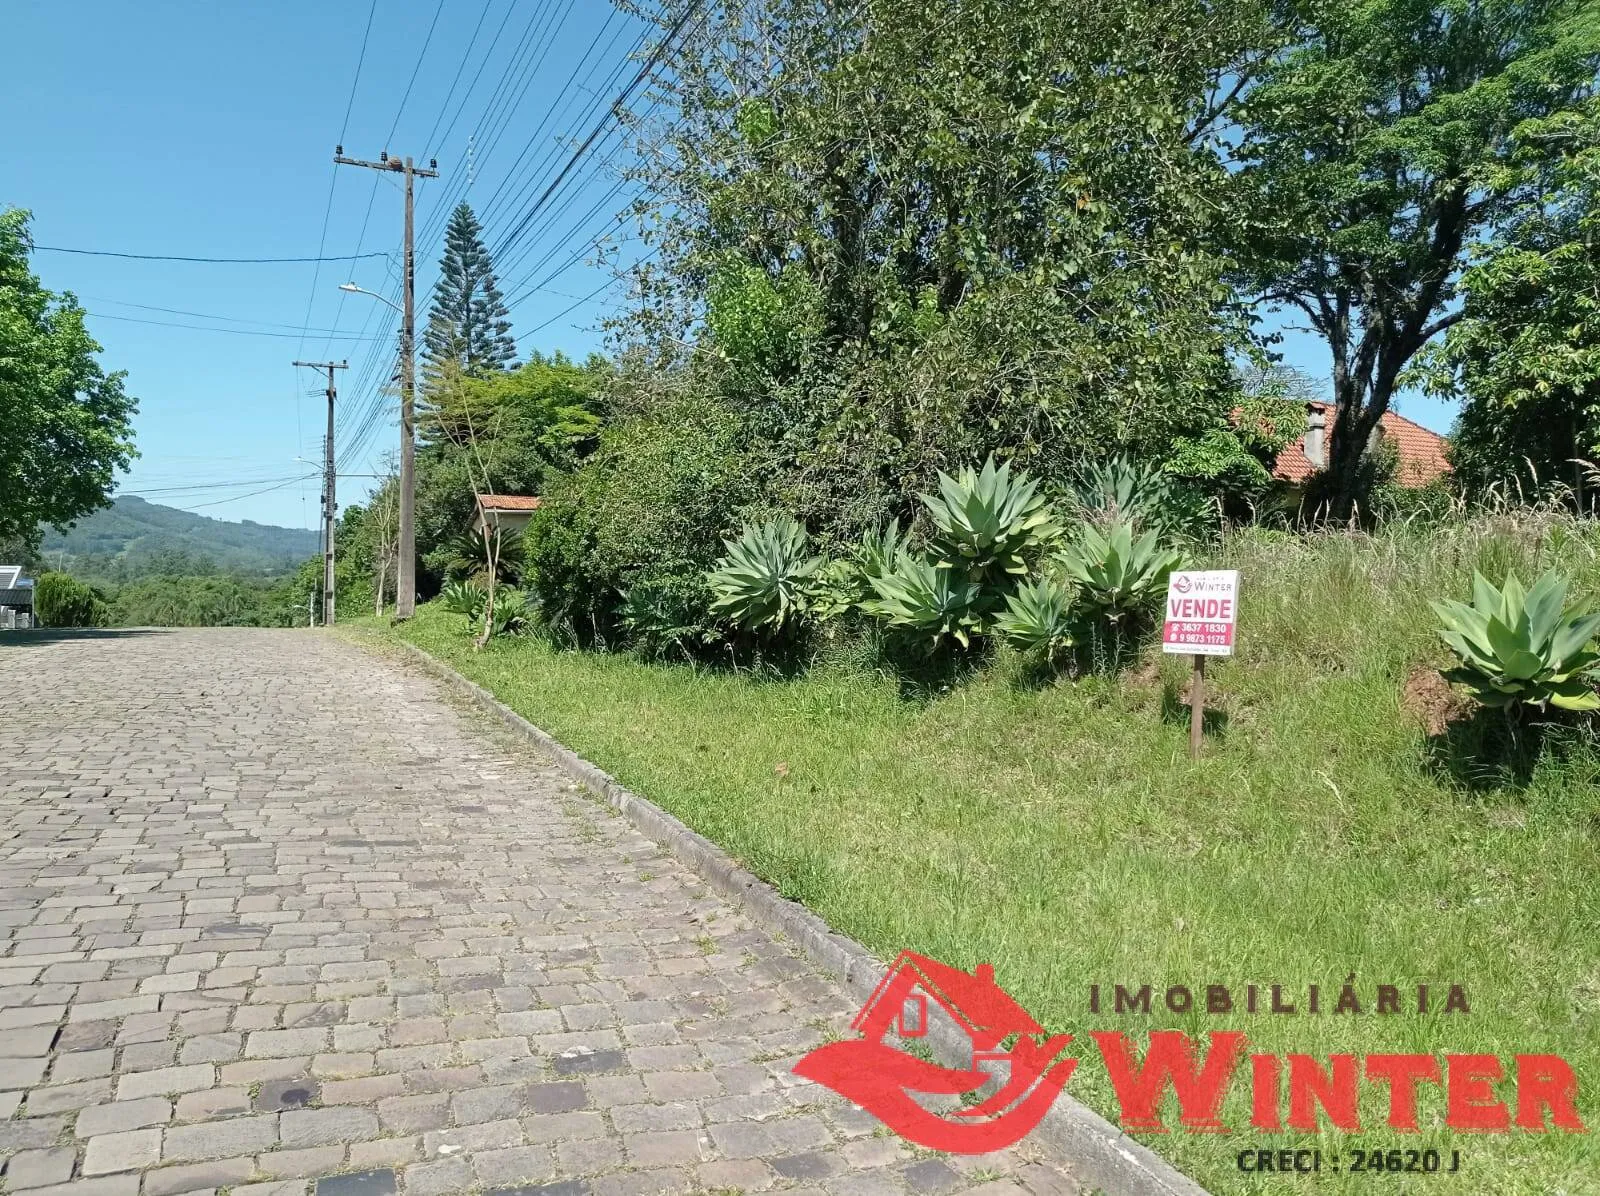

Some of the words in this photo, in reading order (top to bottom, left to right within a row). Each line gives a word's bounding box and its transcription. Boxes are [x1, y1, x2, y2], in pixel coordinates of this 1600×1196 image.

[1171, 599, 1232, 618] VENDE
[1205, 624, 1226, 633] 1830
[1186, 634, 1204, 643] 9873
[1207, 635, 1226, 644] 1175
